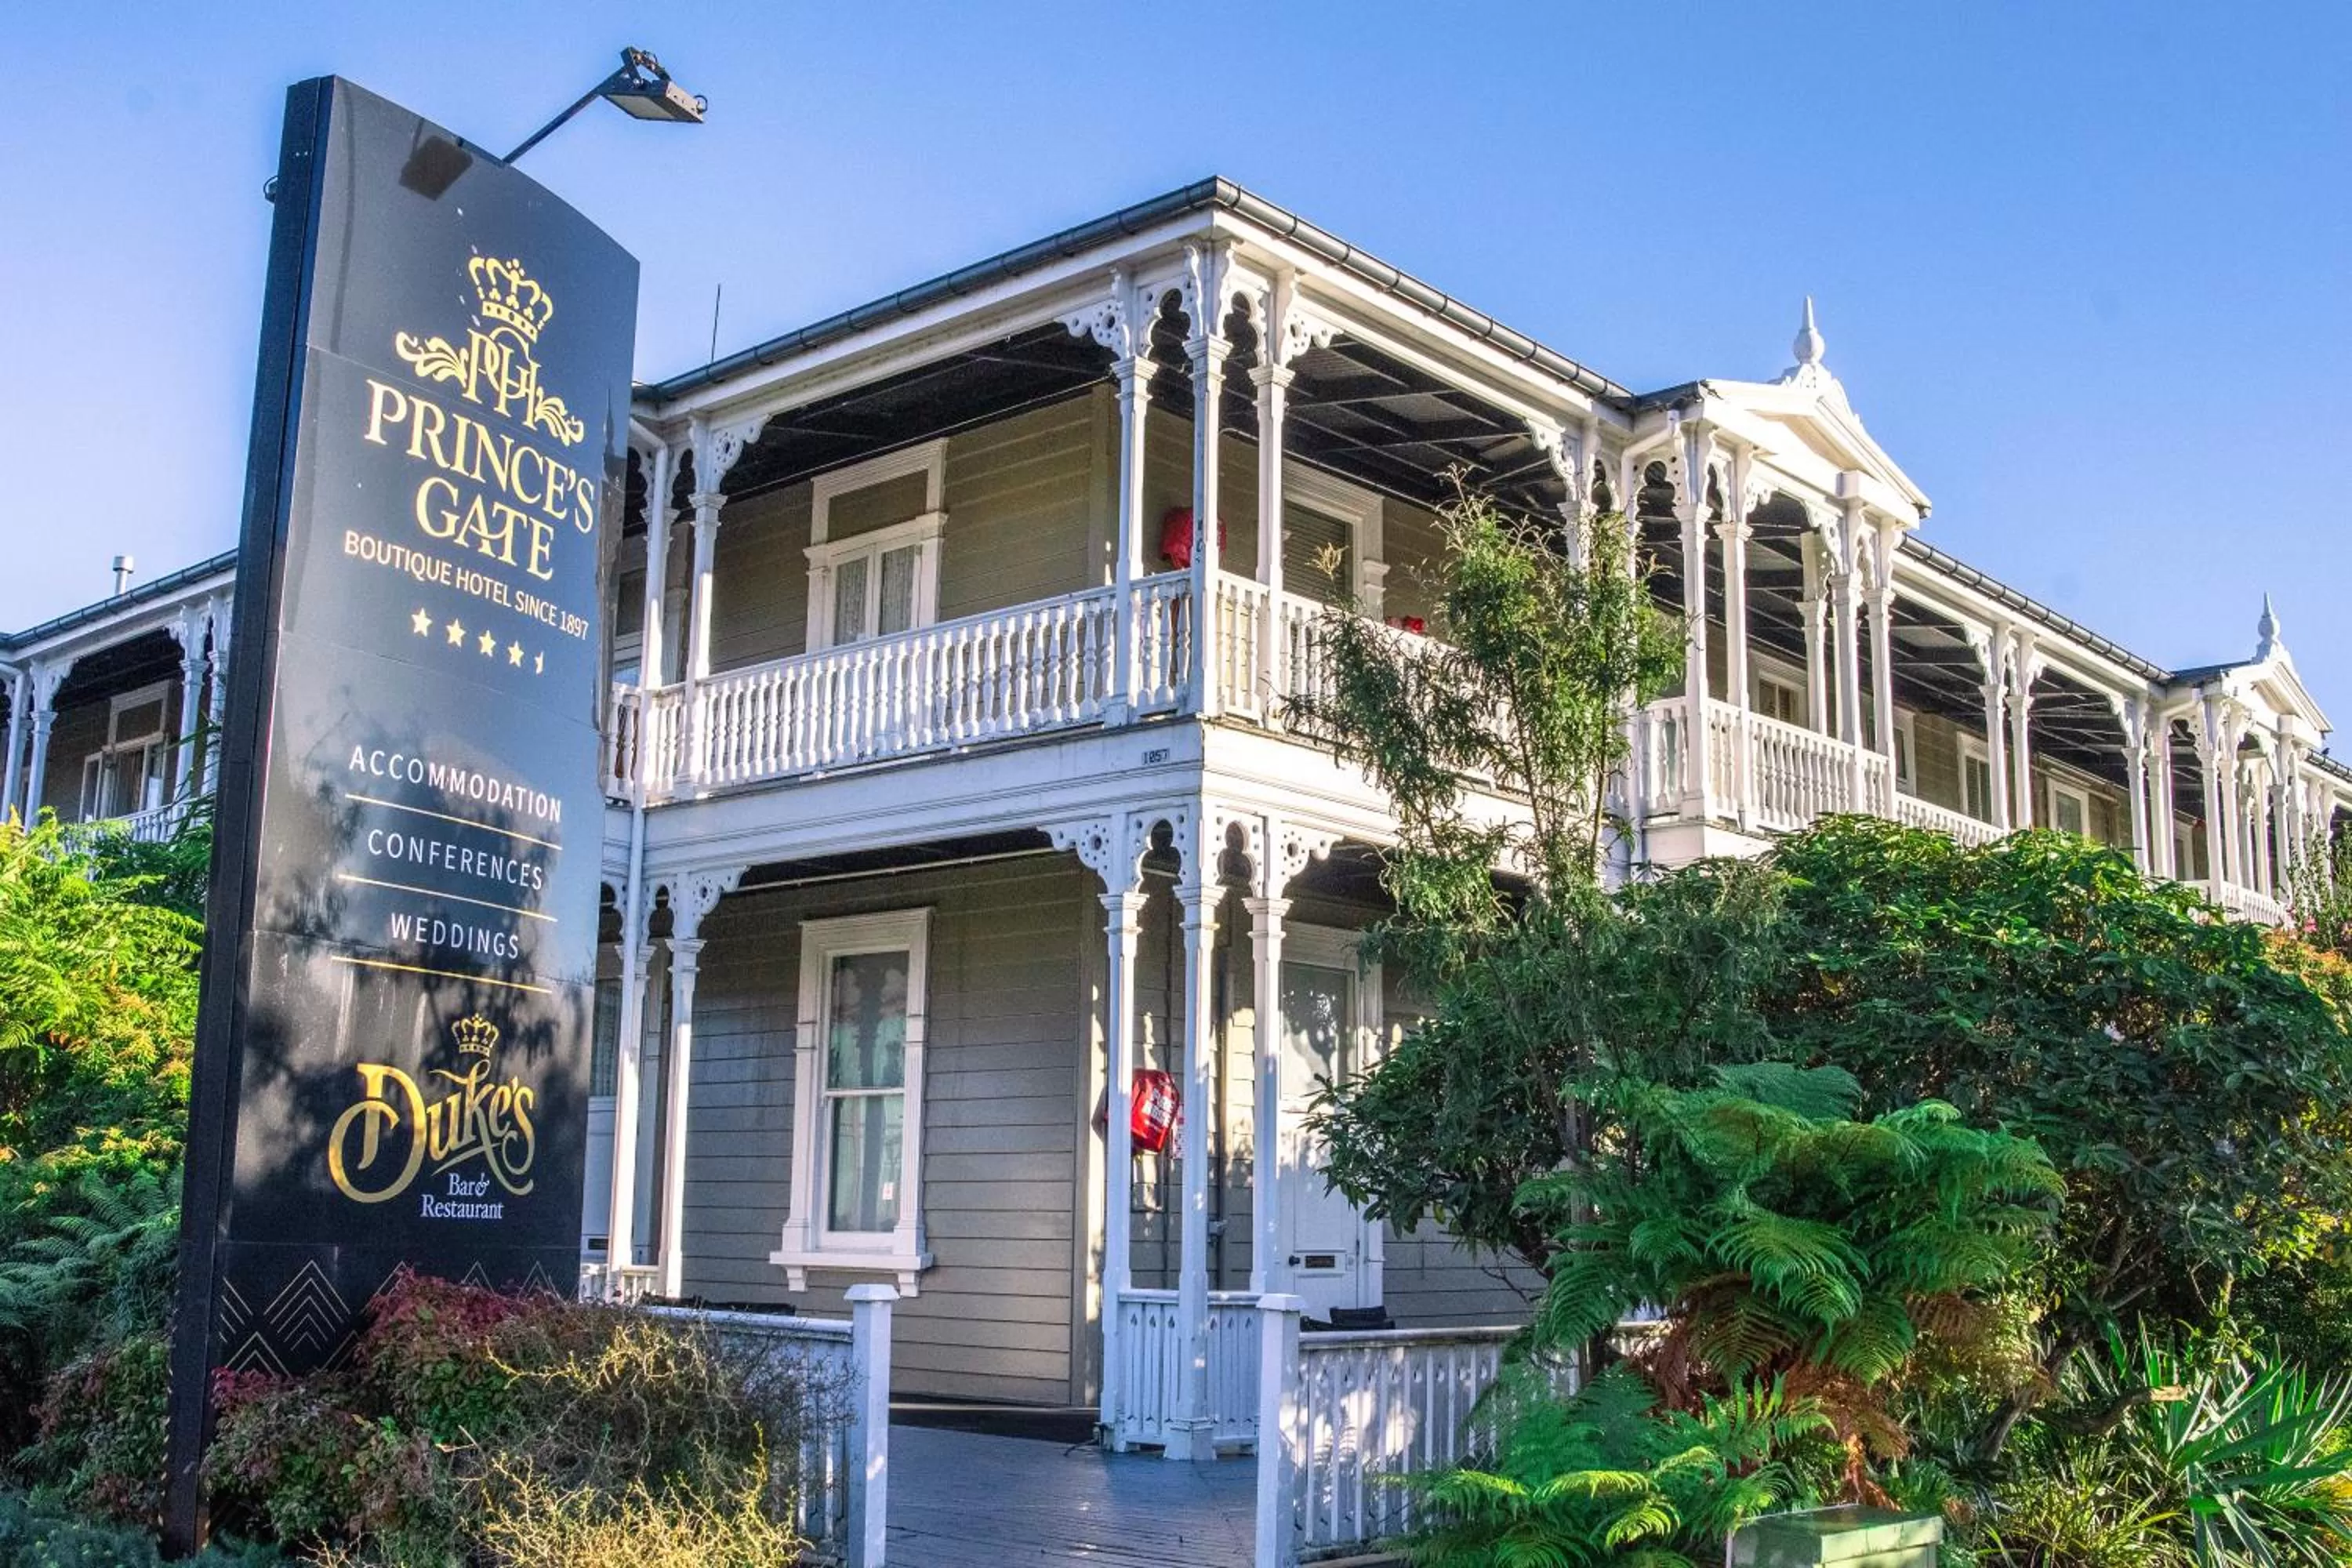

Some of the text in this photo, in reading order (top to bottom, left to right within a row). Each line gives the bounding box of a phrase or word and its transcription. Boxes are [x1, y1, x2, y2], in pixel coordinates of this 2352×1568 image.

[364, 379, 594, 534] PRINCE'S
[416, 477, 555, 580] GATE
[344, 530, 590, 641] BOUTIQUE HOTEL SINCE 1897
[350, 745, 562, 822] ACCOMMODATION
[368, 829, 543, 891] CONFERENCES
[391, 913, 519, 960] WEDDINGS
[328, 1059, 535, 1203] Duke's
[419, 1194, 504, 1220] Restaurant
